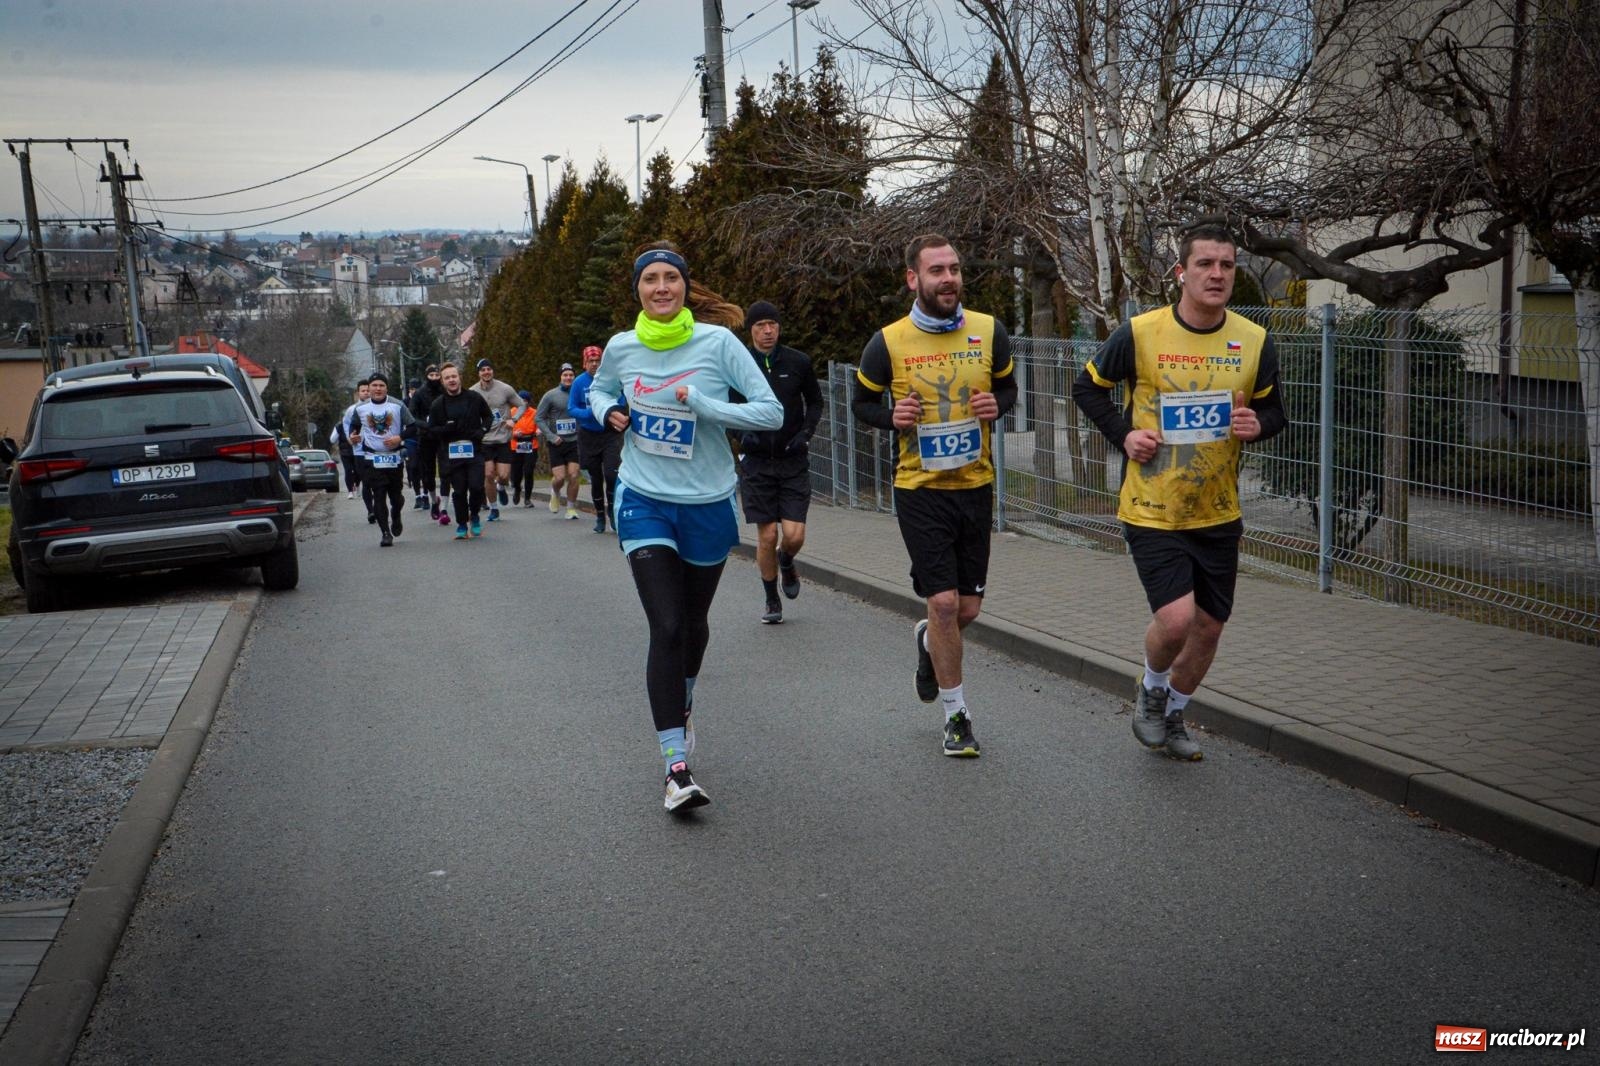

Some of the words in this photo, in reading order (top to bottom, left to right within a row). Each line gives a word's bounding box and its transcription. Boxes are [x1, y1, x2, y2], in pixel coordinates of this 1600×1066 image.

[905, 359, 983, 372] BOLATICE
[1158, 363, 1241, 373] BOLATICE
[1174, 405, 1221, 428] 136
[638, 415, 682, 442] 142
[931, 432, 972, 456] 195
[122, 469, 141, 482] OP
[148, 465, 191, 479] 1239P
